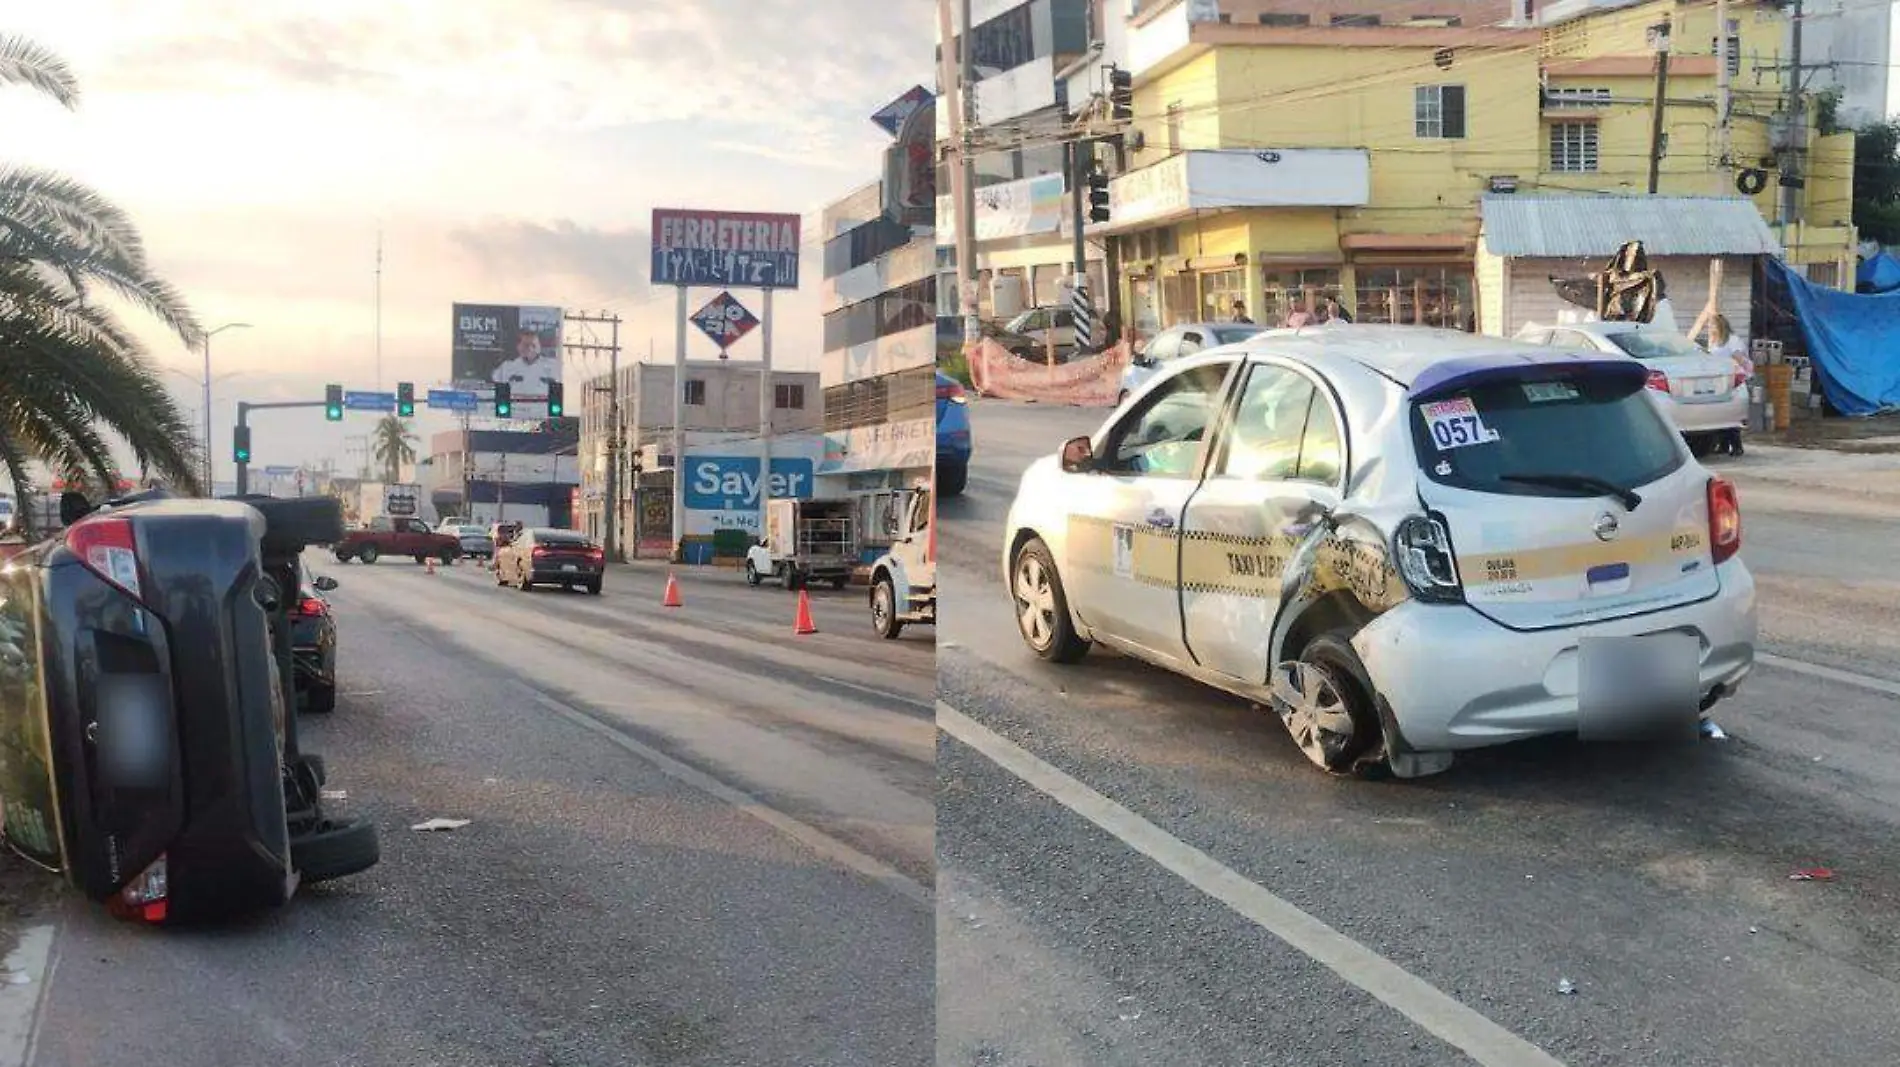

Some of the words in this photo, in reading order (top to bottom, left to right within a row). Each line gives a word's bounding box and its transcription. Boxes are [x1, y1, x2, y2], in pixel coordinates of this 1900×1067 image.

[660, 217, 795, 252] FERRETERIA
[460, 315, 498, 331] BKM
[1433, 416, 1479, 447] 057
[694, 462, 805, 505] Sayer
[1226, 552, 1255, 576] TAXI
